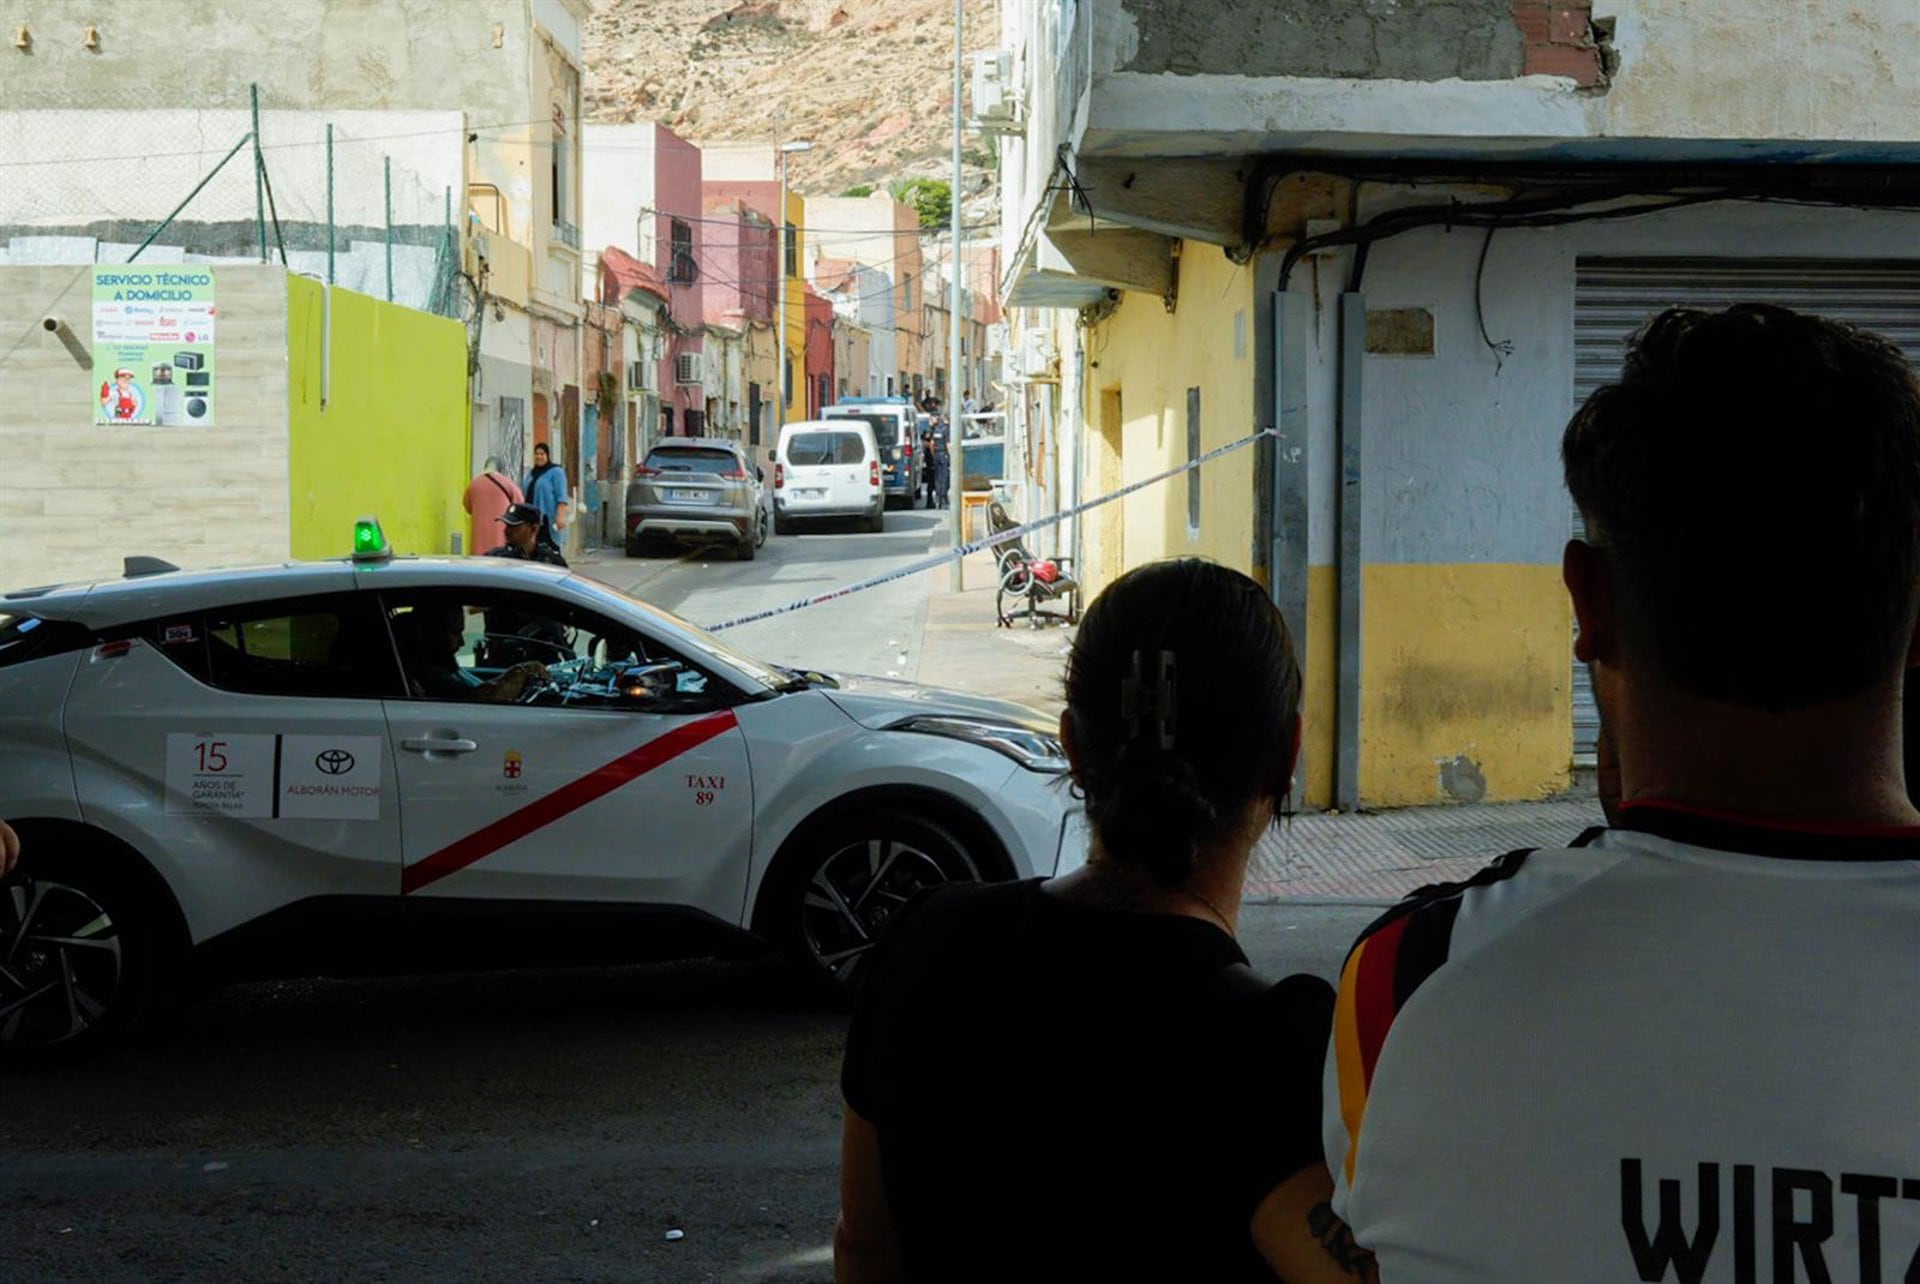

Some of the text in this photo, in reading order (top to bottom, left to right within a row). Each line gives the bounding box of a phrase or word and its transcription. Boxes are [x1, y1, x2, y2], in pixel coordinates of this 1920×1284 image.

[96, 272, 210, 286] SERVICIO TÉCNICO
[114, 289, 192, 301] A DOMICILIO
[194, 742, 228, 773] 15
[192, 779, 237, 791] AÑOS DE
[685, 774, 725, 790] TAXI
[287, 784, 338, 796] ALBORÁN
[696, 791, 713, 806] 89
